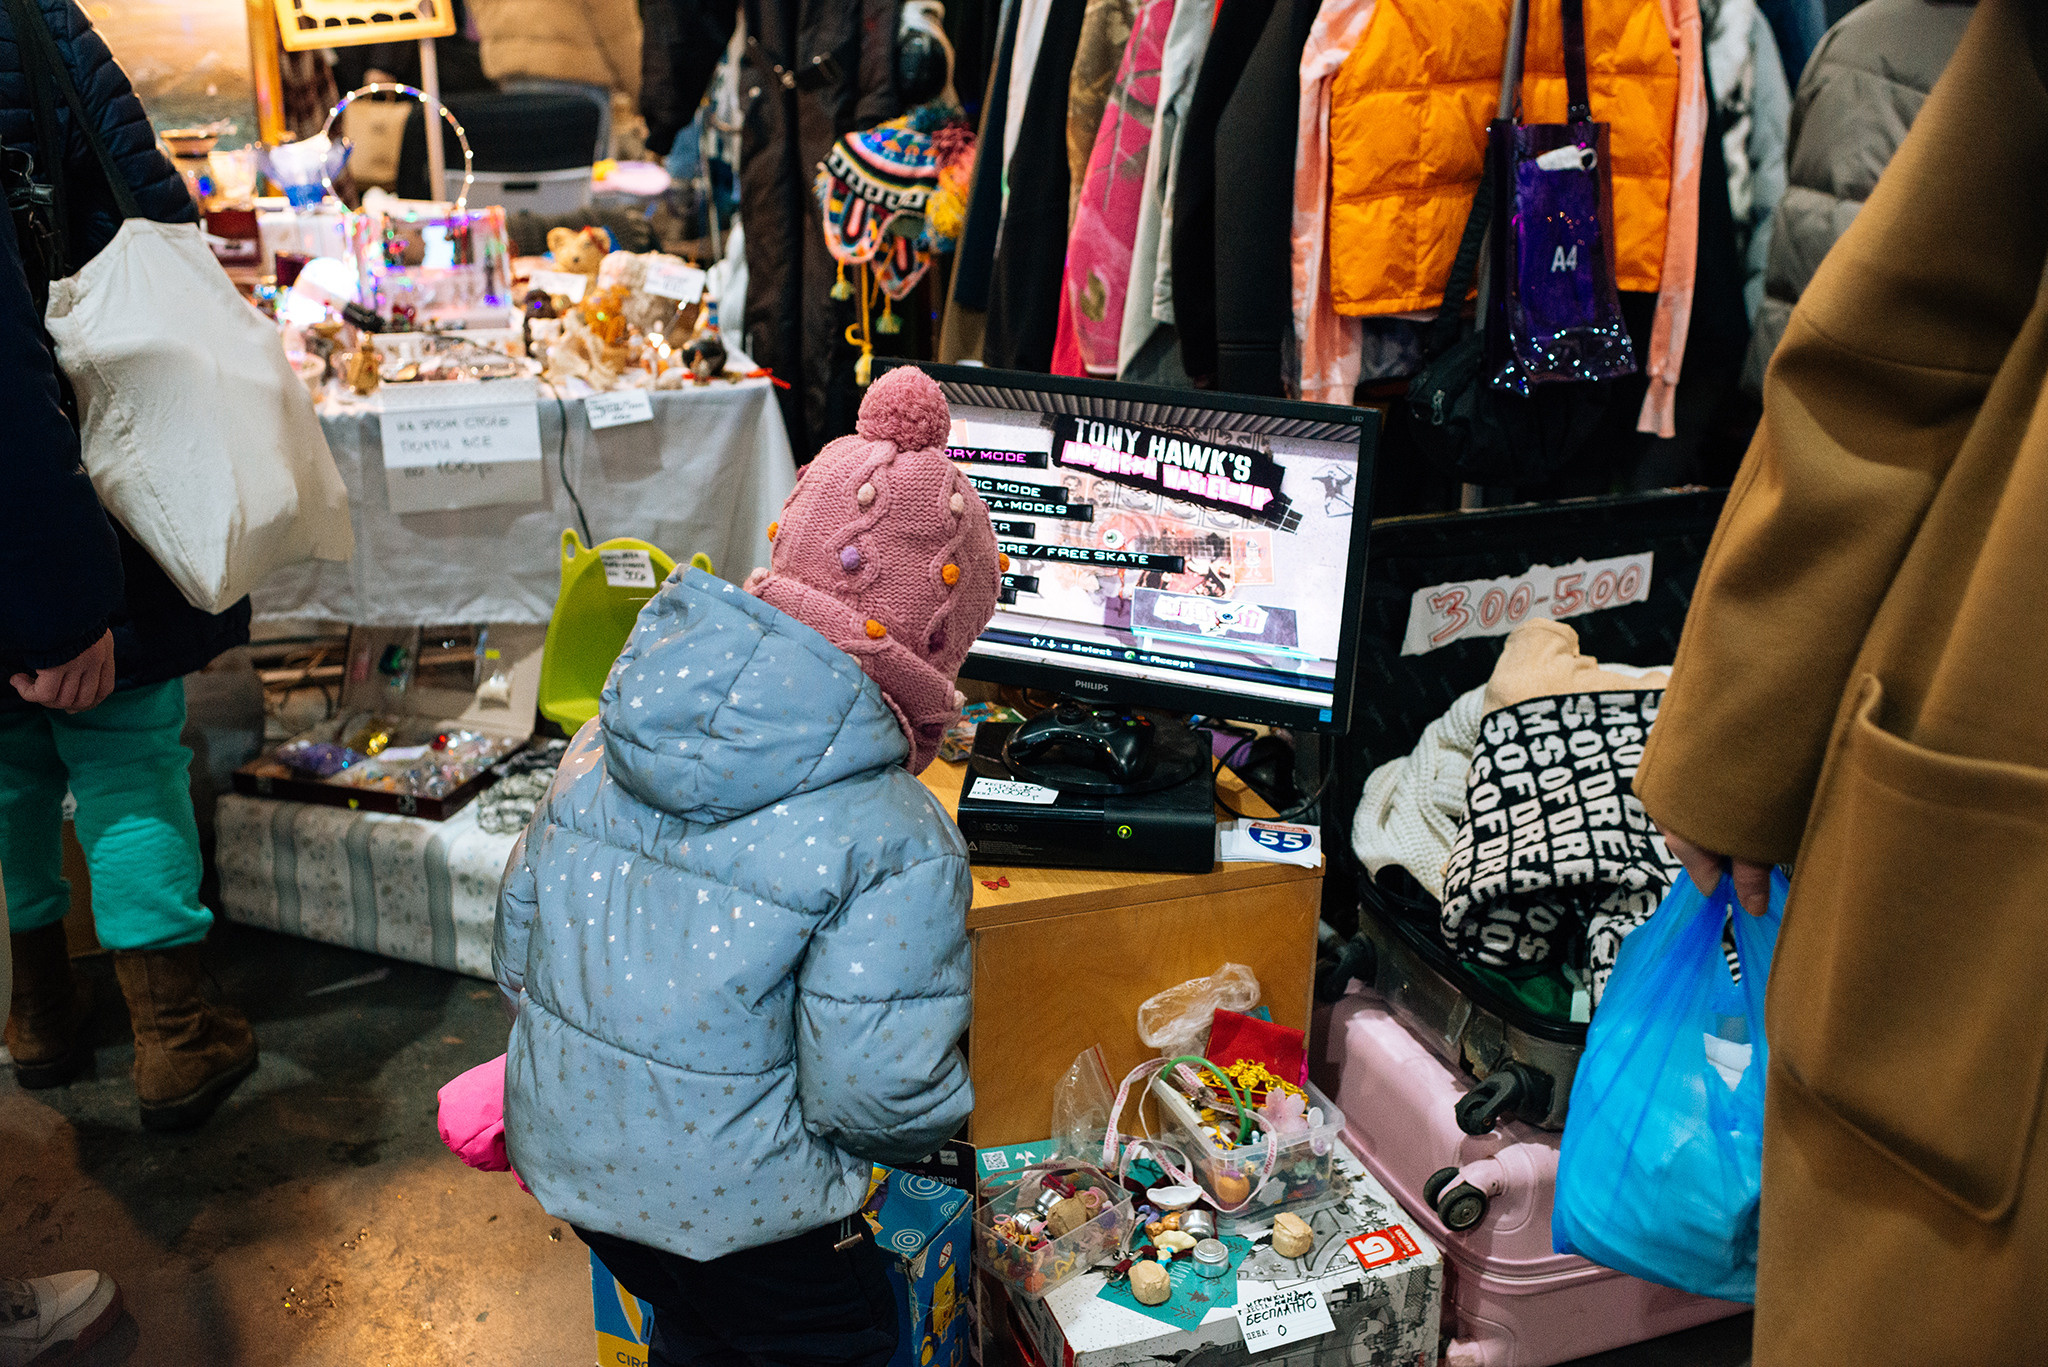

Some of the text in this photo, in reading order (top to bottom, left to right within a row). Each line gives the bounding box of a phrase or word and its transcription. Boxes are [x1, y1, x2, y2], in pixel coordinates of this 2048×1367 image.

[1550, 245, 1578, 273] A4
[944, 447, 1026, 463] ORY MODE
[1074, 418, 1252, 482] TONY HAWK'S
[996, 482, 1041, 497] MODE
[992, 521, 1011, 532] ER
[997, 543, 1028, 555] ORE
[1047, 547, 1089, 560] FREE
[1094, 549, 1149, 565] SKATE
[1427, 561, 1643, 649] 300-500
[1075, 680, 1109, 692] PHILIPS
[1258, 829, 1304, 849] 55
[1246, 1297, 1317, 1326] БЕСПЛАТНО
[1277, 1324, 1287, 1336] 0
